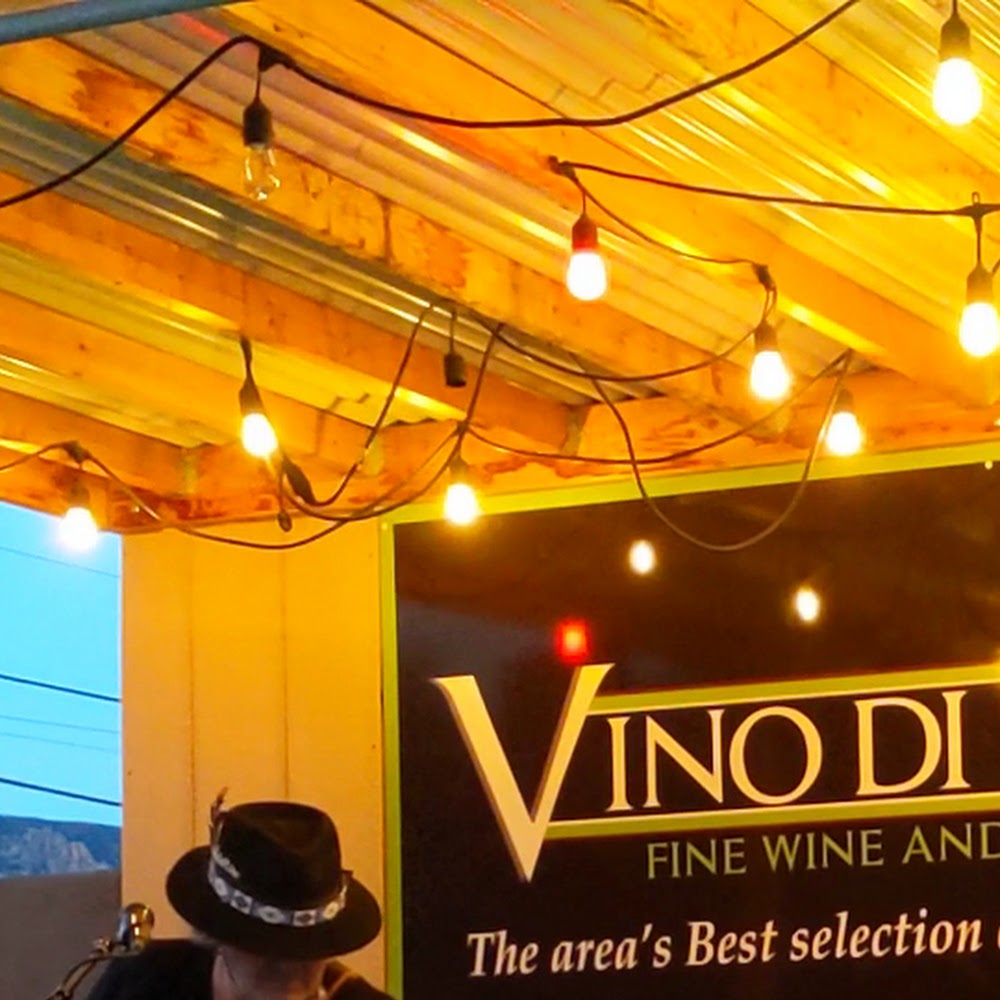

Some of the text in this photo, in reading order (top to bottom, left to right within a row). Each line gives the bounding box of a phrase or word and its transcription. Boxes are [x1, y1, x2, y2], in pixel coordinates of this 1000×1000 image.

[429, 663, 822, 882] VINO
[854, 690, 971, 796] DI
[646, 837, 747, 880] FINE
[762, 828, 884, 872] WINE
[466, 929, 538, 978] The
[551, 923, 672, 972] area's
[685, 917, 779, 967] Best
[788, 907, 983, 961] selection
